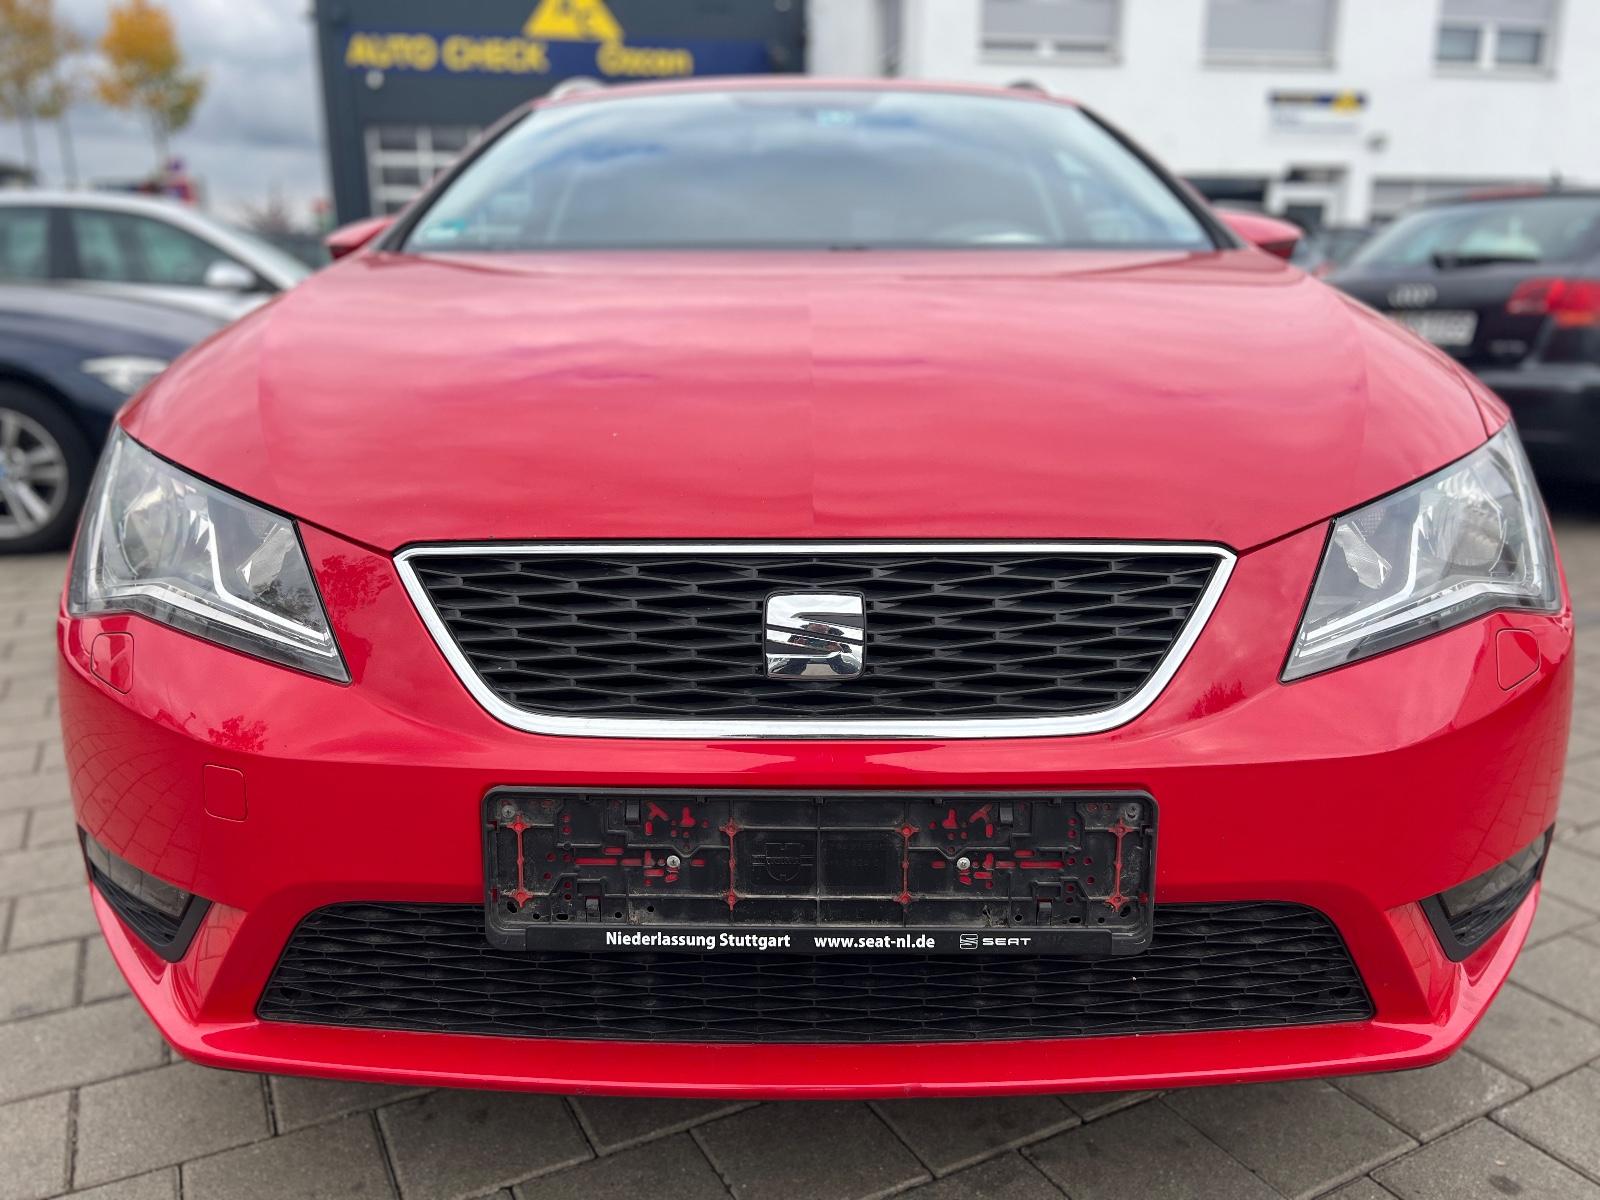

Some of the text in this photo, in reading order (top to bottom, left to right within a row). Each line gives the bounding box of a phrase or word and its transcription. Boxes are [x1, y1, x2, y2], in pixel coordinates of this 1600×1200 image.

[347, 35, 438, 69] AUTO
[442, 36, 548, 73] CHECK
[606, 931, 1032, 951] Niederlassung Stuttgart www.seat-nl.de SEAT
